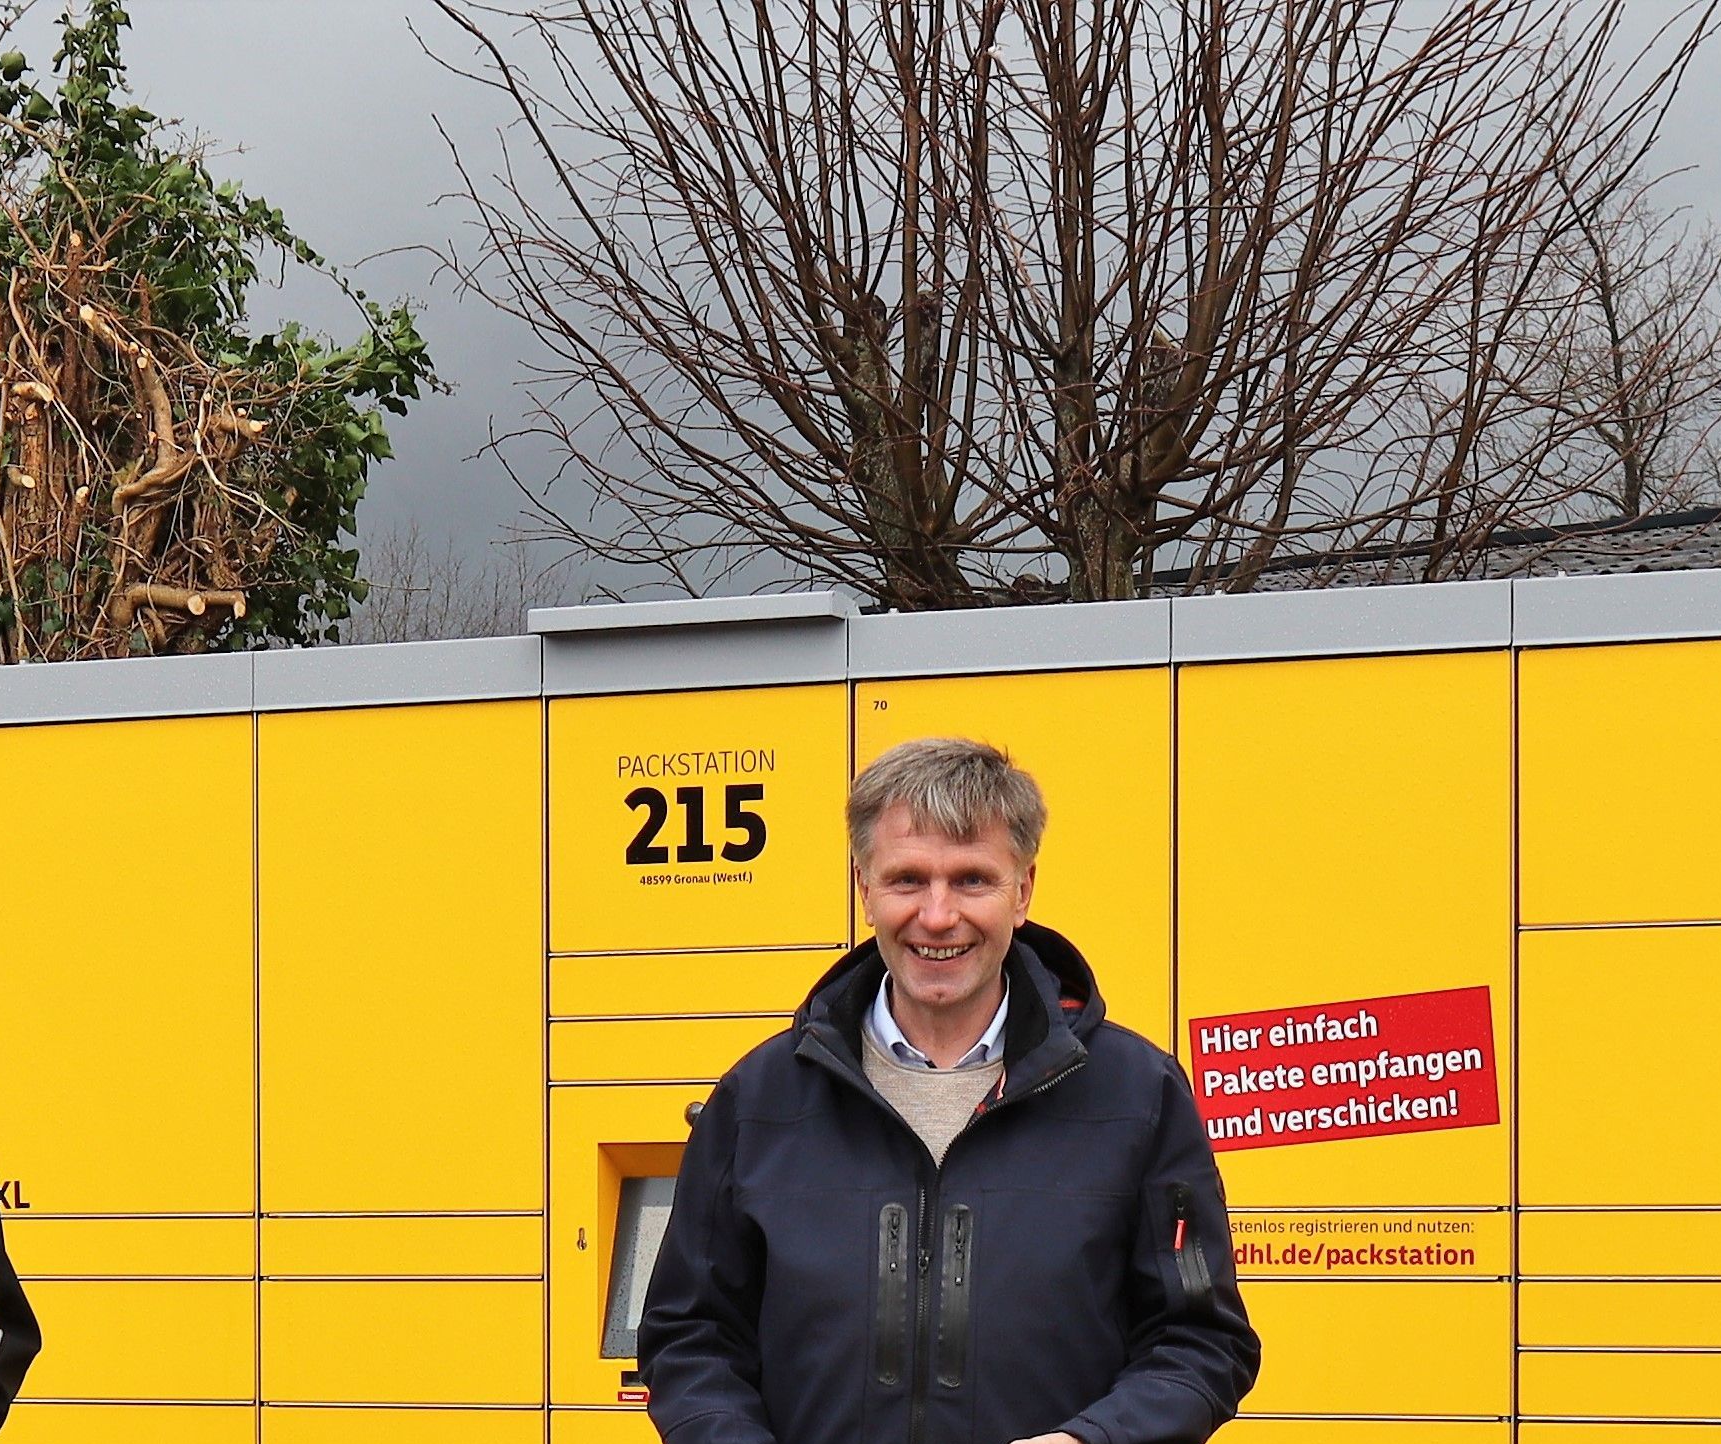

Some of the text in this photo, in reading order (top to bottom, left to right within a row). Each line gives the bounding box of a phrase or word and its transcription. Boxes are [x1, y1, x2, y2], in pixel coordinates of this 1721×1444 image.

[873, 700, 888, 711] 70
[618, 749, 775, 778] PACKSTATION
[624, 784, 767, 865] 215
[639, 871, 753, 886] 48599 Gronau (Westf.)
[1199, 1009, 1378, 1055] Hier einfach
[1203, 1046, 1482, 1097] Pakete empfangen
[1206, 1090, 1458, 1140] und verschicken!
[1229, 1218, 1475, 1236] stenlos registrieren und nutzen:
[1233, 1243, 1475, 1270] dhl.de/packstation
